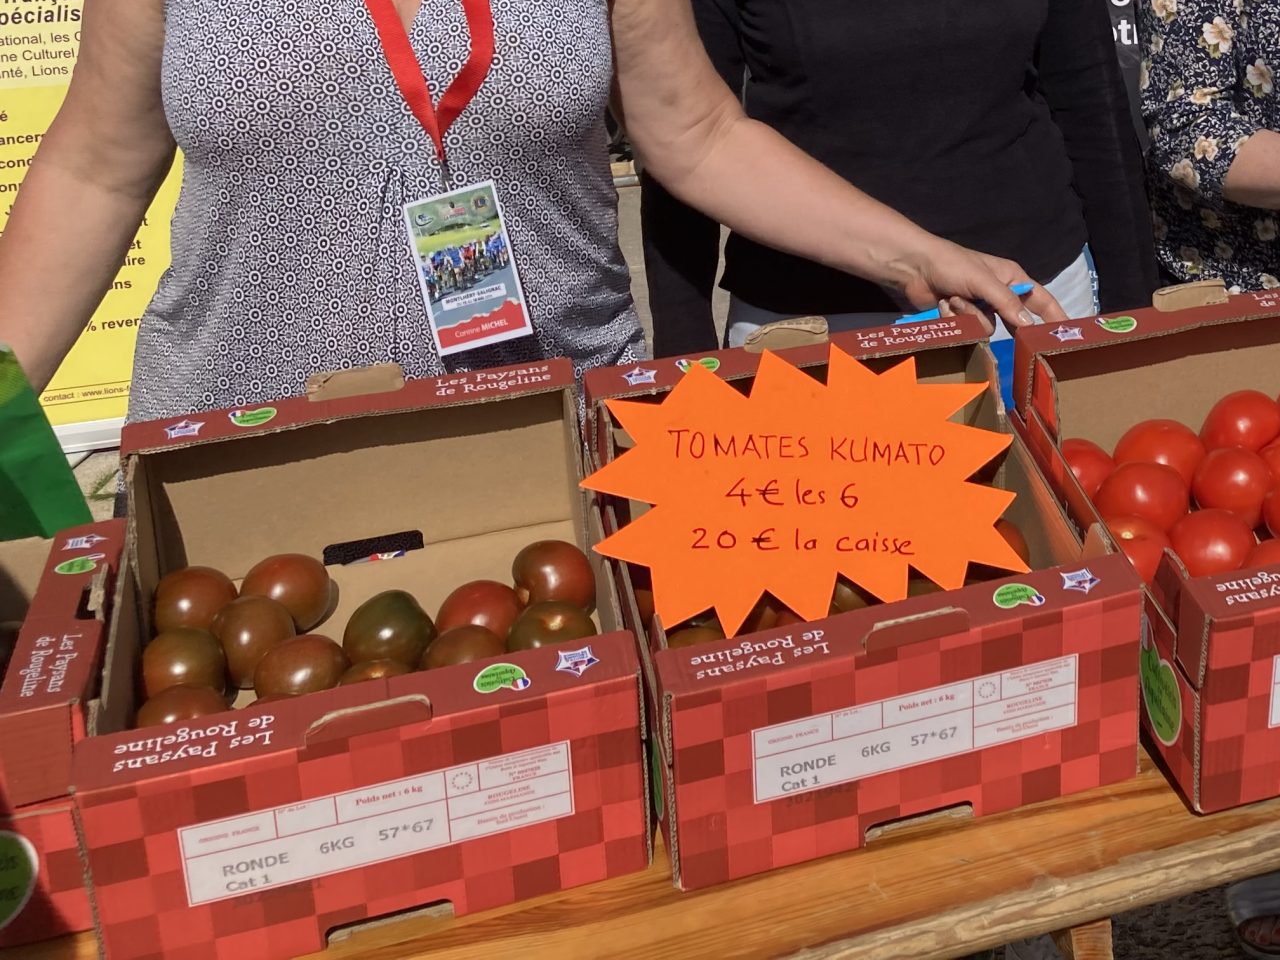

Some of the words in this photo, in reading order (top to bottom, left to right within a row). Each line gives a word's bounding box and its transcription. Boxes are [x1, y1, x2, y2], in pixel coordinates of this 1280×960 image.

[51, 32, 70, 43] les
[32, 65, 69, 78] Lions
[856, 330, 885, 341] Les
[892, 320, 957, 337] Paysans
[860, 339, 879, 348] de
[884, 327, 962, 347] Rougeline
[435, 377, 468, 388] Les
[475, 364, 549, 382] Paysans
[435, 386, 456, 396] de
[463, 373, 552, 393] Rougeline
[668, 428, 810, 460] TOMATES
[829, 436, 946, 467] KUMATO
[794, 477, 826, 506] les
[840, 481, 859, 509] 6
[691, 527, 738, 551] 20
[750, 527, 781, 551] €
[794, 527, 818, 551] la
[835, 531, 916, 557] caisse
[35, 636, 56, 648] de
[60, 634, 83, 650] Les
[802, 630, 825, 641] de
[690, 638, 795, 665] Rougeline
[793, 642, 830, 658] Les
[19, 649, 53, 698] Rougeline
[47, 652, 78, 693] Paysans
[696, 652, 785, 680] Paysans
[248, 715, 275, 728] de
[113, 721, 238, 754] Rougeline
[230, 730, 274, 748] Les
[112, 741, 218, 772] Paysans
[780, 755, 837, 778] RONDE
[861, 741, 891, 758] 6KG
[782, 779, 807, 793] Cat
[812, 774, 821, 784] 1
[355, 793, 380, 807] Poids
[382, 791, 396, 801] net
[412, 785, 424, 796] kg
[222, 851, 290, 878] RONDE
[319, 836, 355, 855] 6KG
[225, 876, 258, 893] Cat
[262, 873, 272, 885] 1
